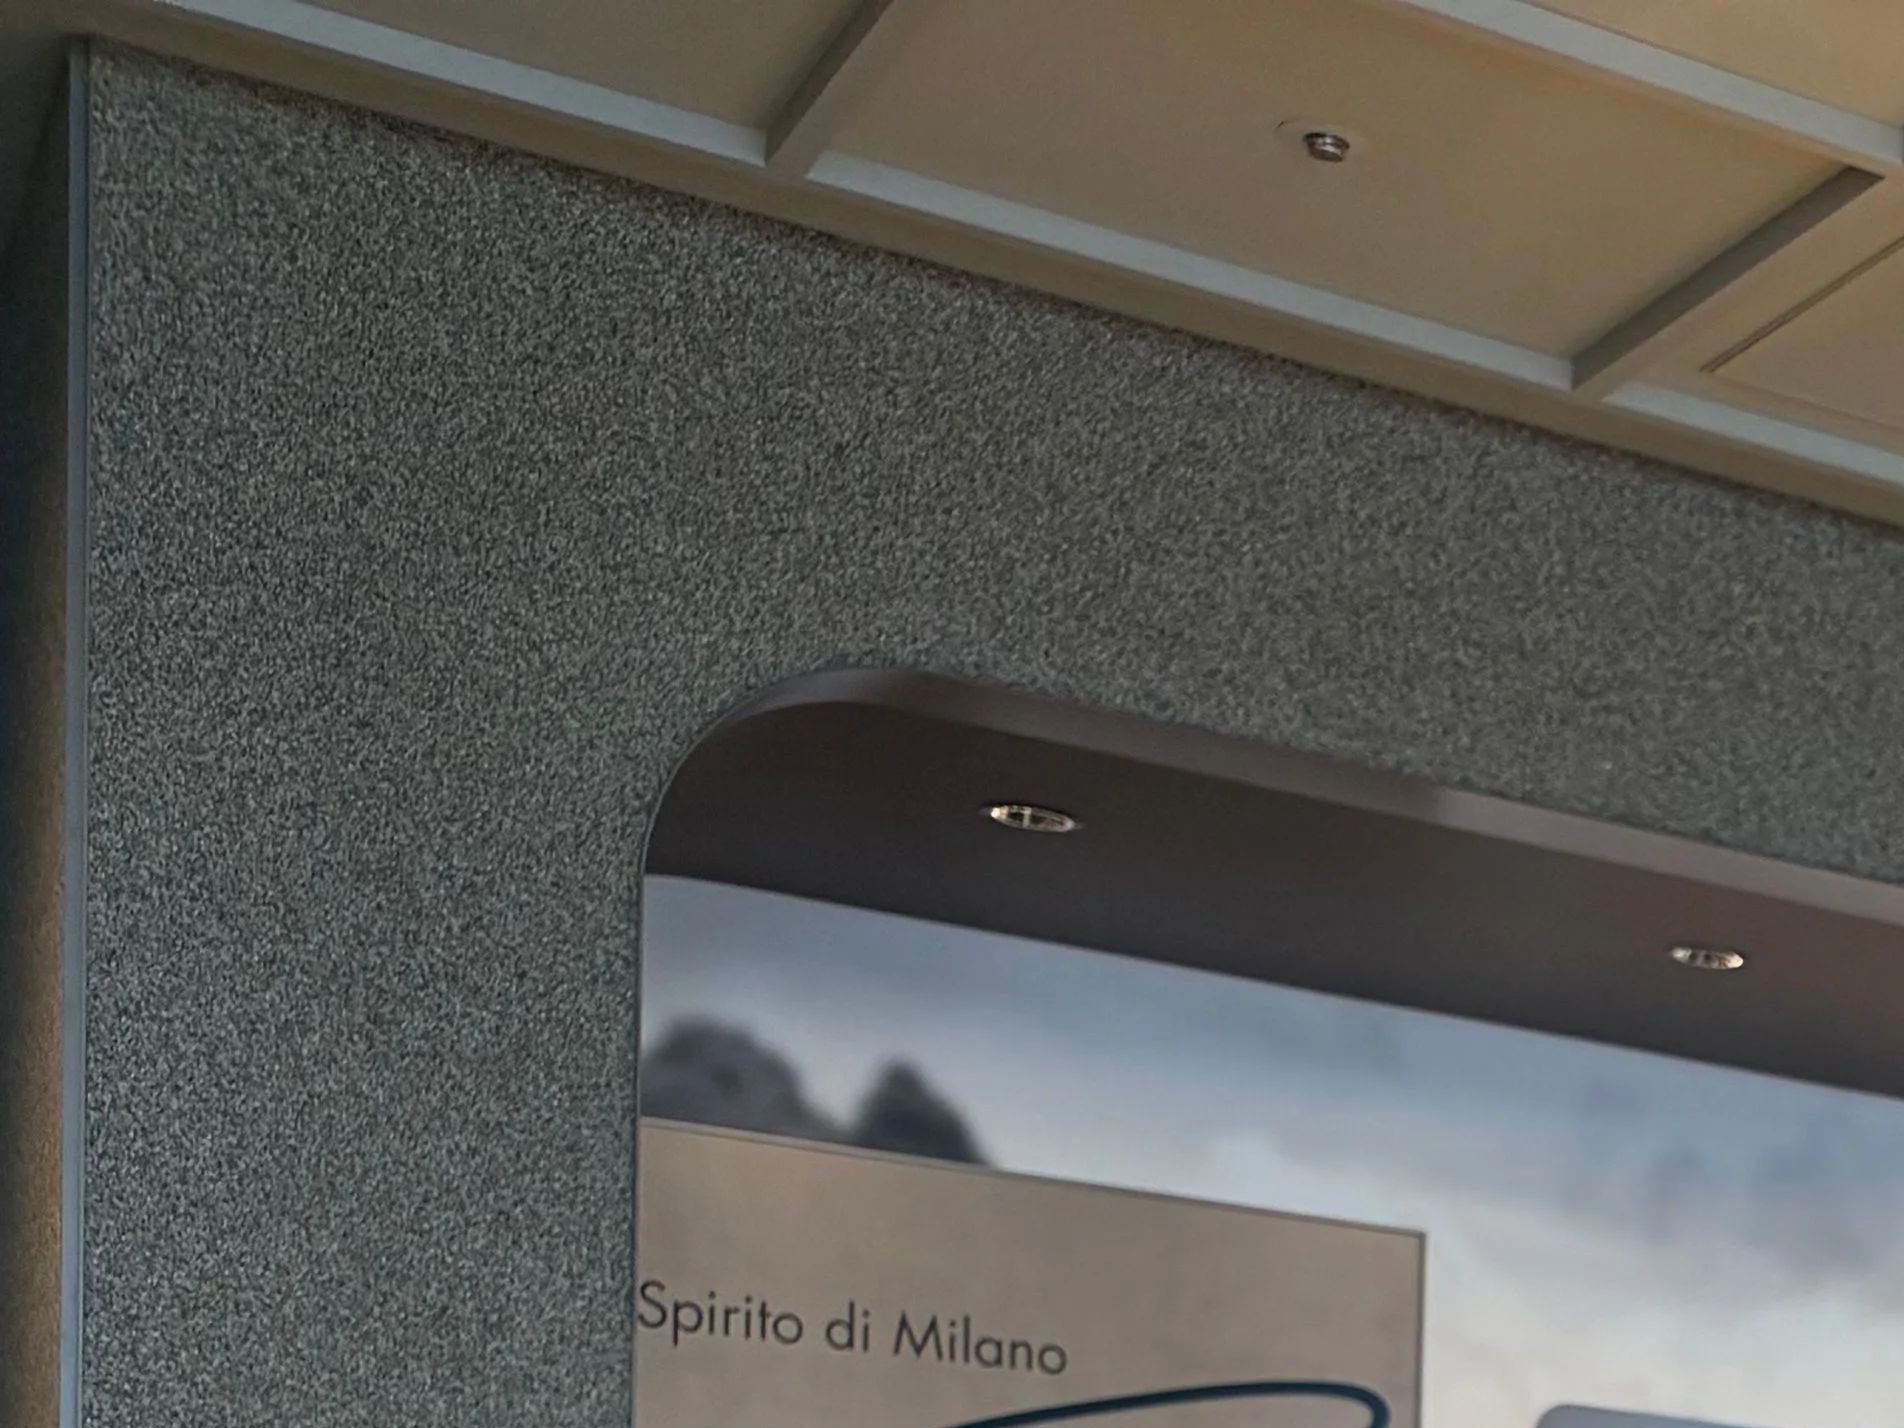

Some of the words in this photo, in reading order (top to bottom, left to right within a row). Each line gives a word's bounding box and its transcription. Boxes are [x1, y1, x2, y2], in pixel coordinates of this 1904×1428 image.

[637, 1280, 804, 1349] Spirito
[825, 1300, 870, 1353] di
[892, 1309, 1068, 1376] Milano
